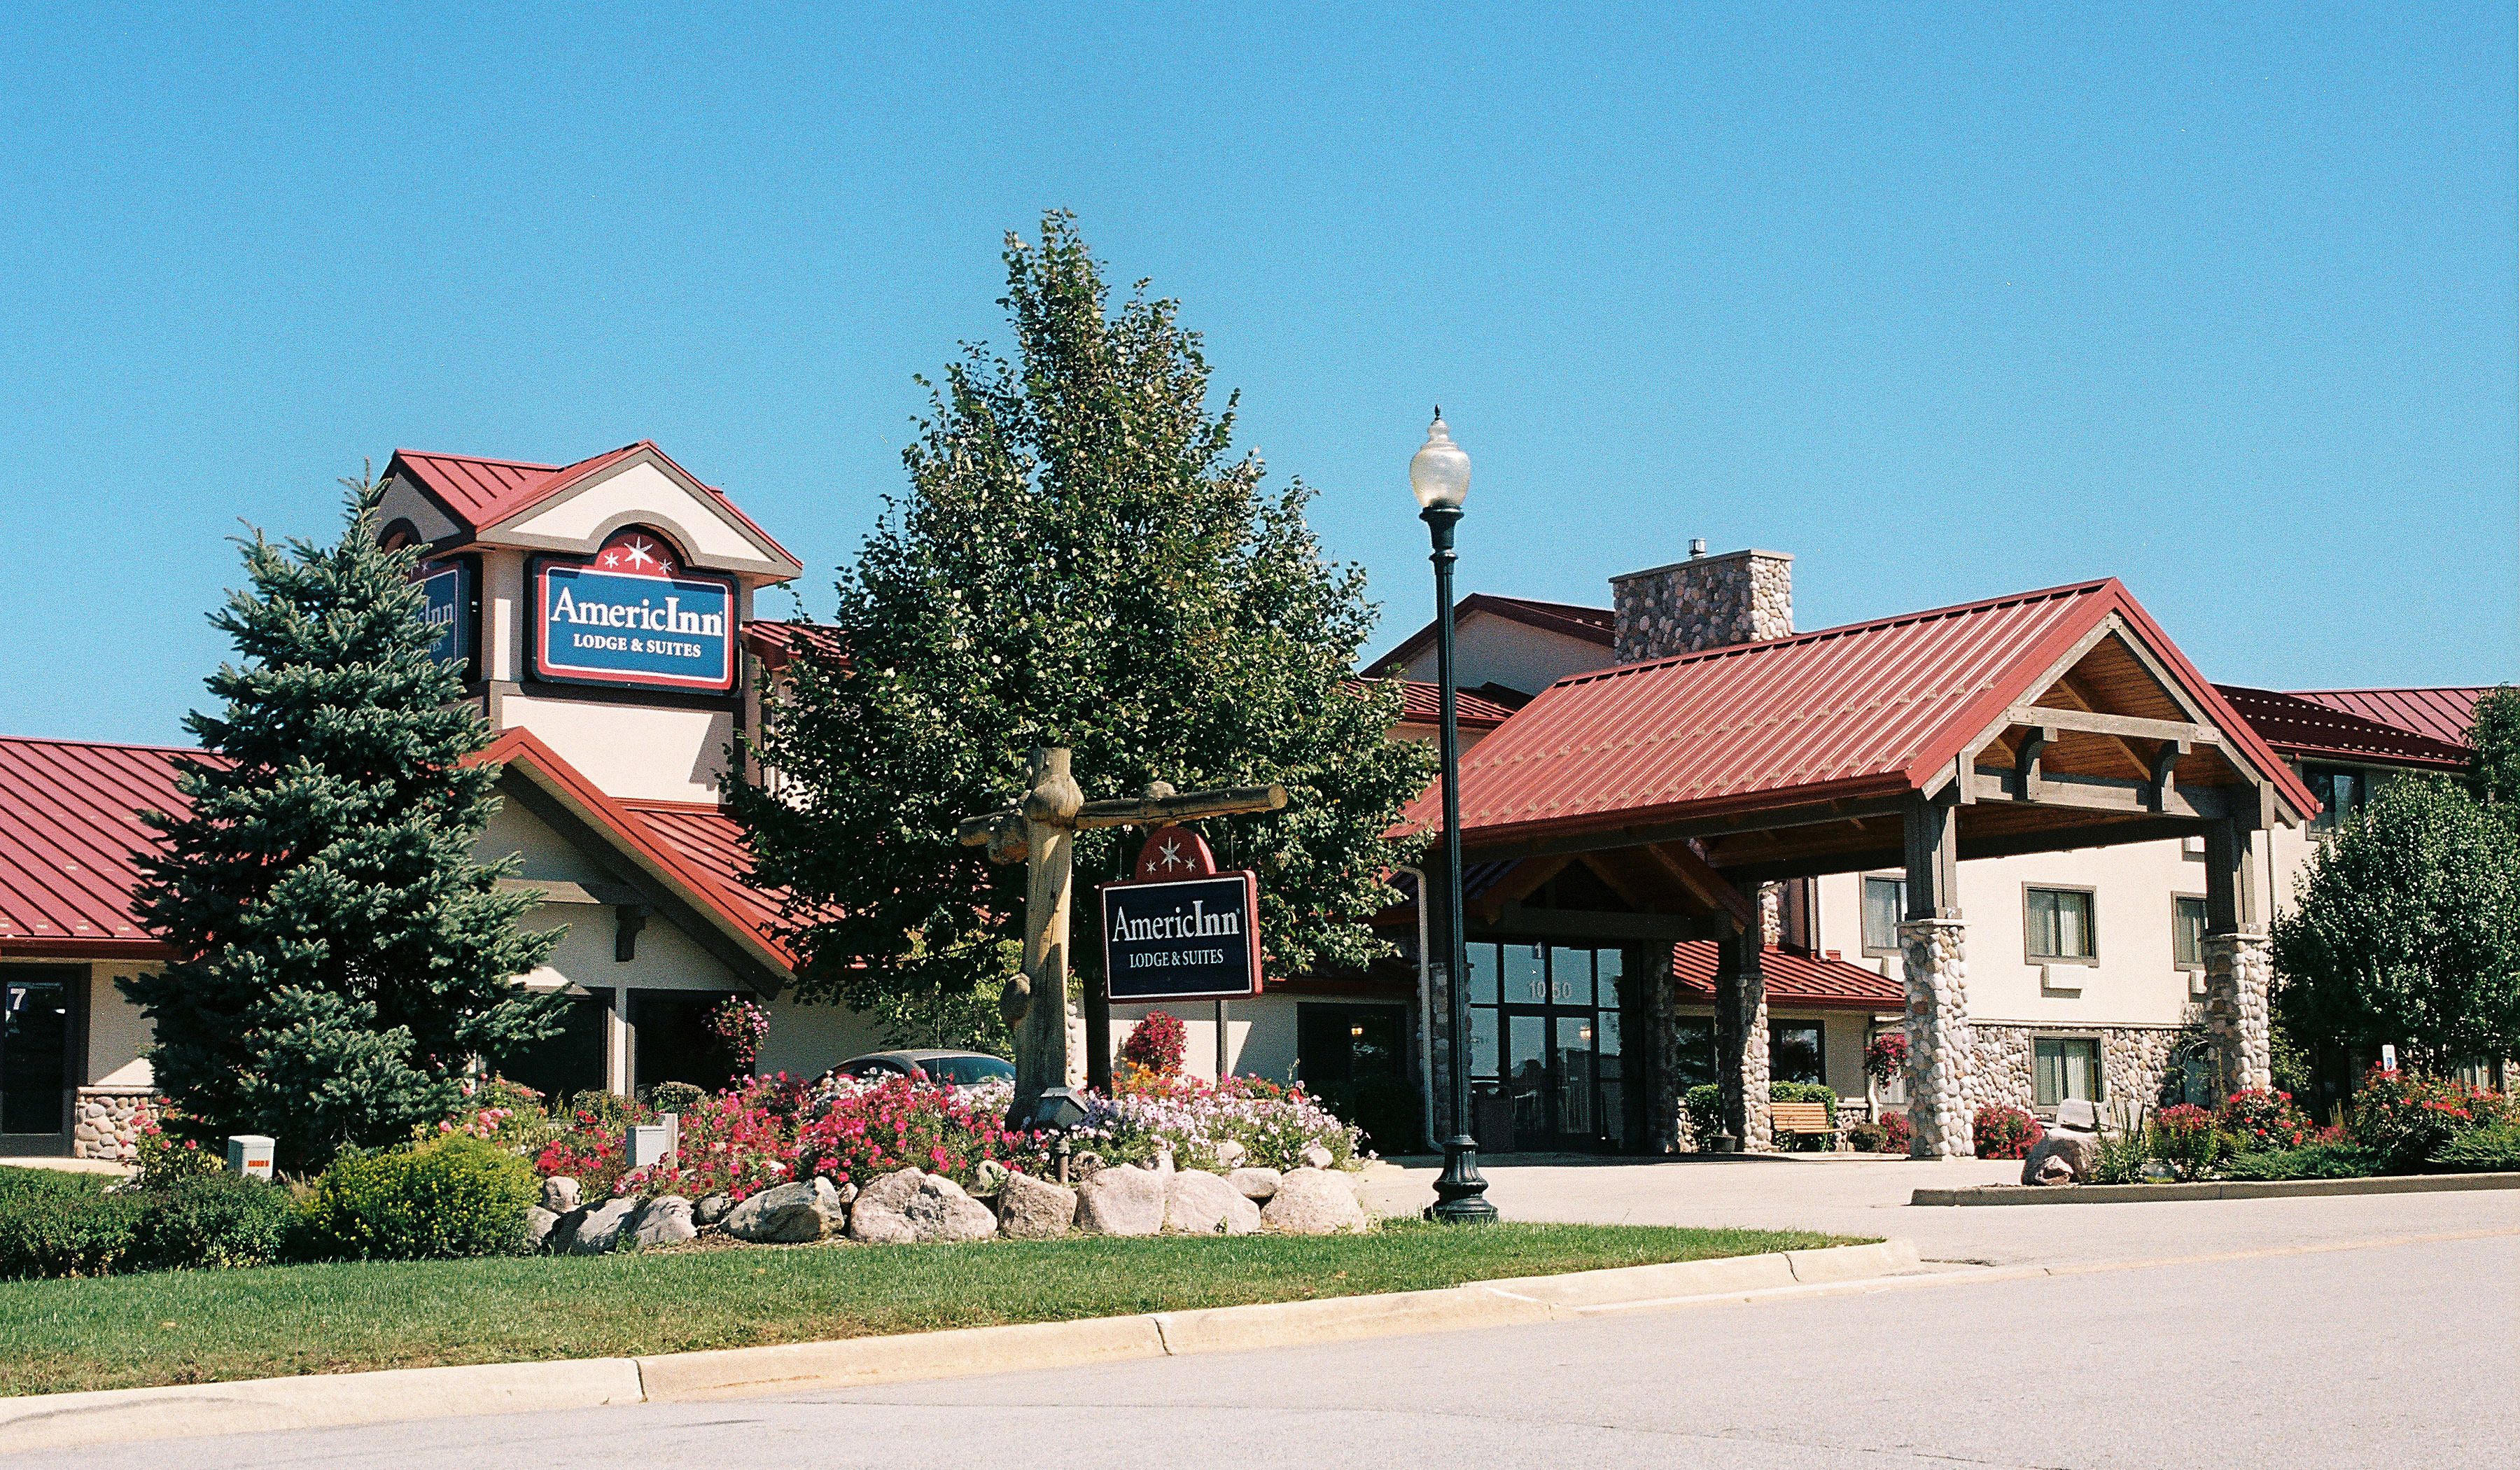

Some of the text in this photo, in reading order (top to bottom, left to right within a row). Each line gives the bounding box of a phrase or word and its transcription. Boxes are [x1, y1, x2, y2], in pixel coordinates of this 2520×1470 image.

[550, 586, 724, 637] AmericInn
[573, 633, 701, 658] LODGE & SUITES
[1112, 899, 1240, 942] AmericInn
[1129, 948, 1224, 968] LODGE & SUITES
[1534, 941, 1542, 959] 1
[10, 988, 27, 1010] 7
